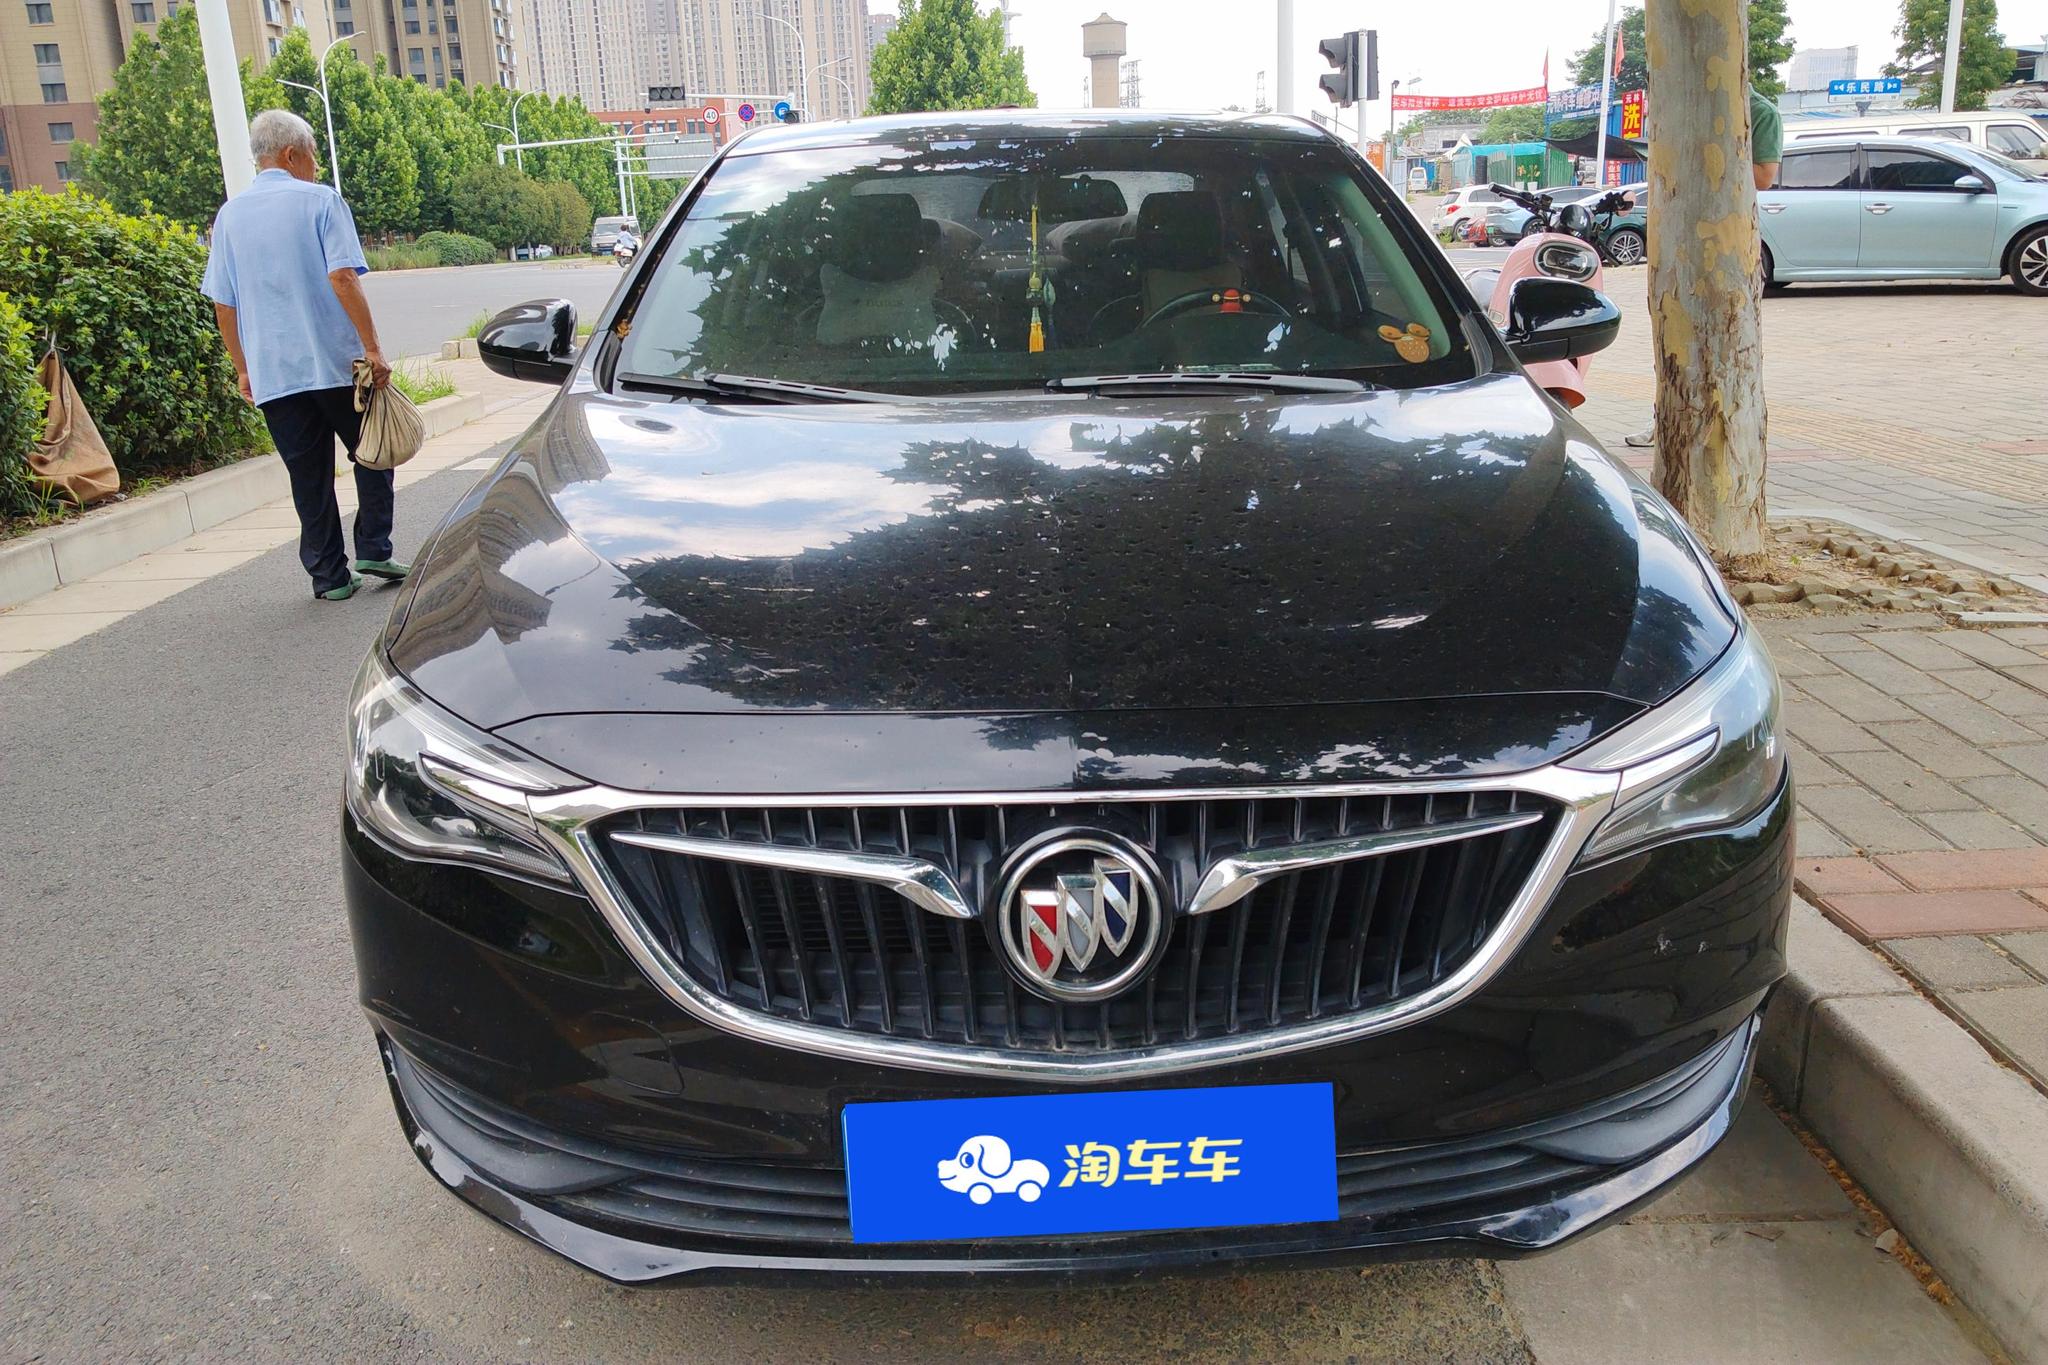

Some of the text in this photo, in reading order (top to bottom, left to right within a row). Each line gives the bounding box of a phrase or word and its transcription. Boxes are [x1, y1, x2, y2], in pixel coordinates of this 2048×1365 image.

[1846, 81, 1885, 94] 乐民路
[706, 111, 716, 120] 40
